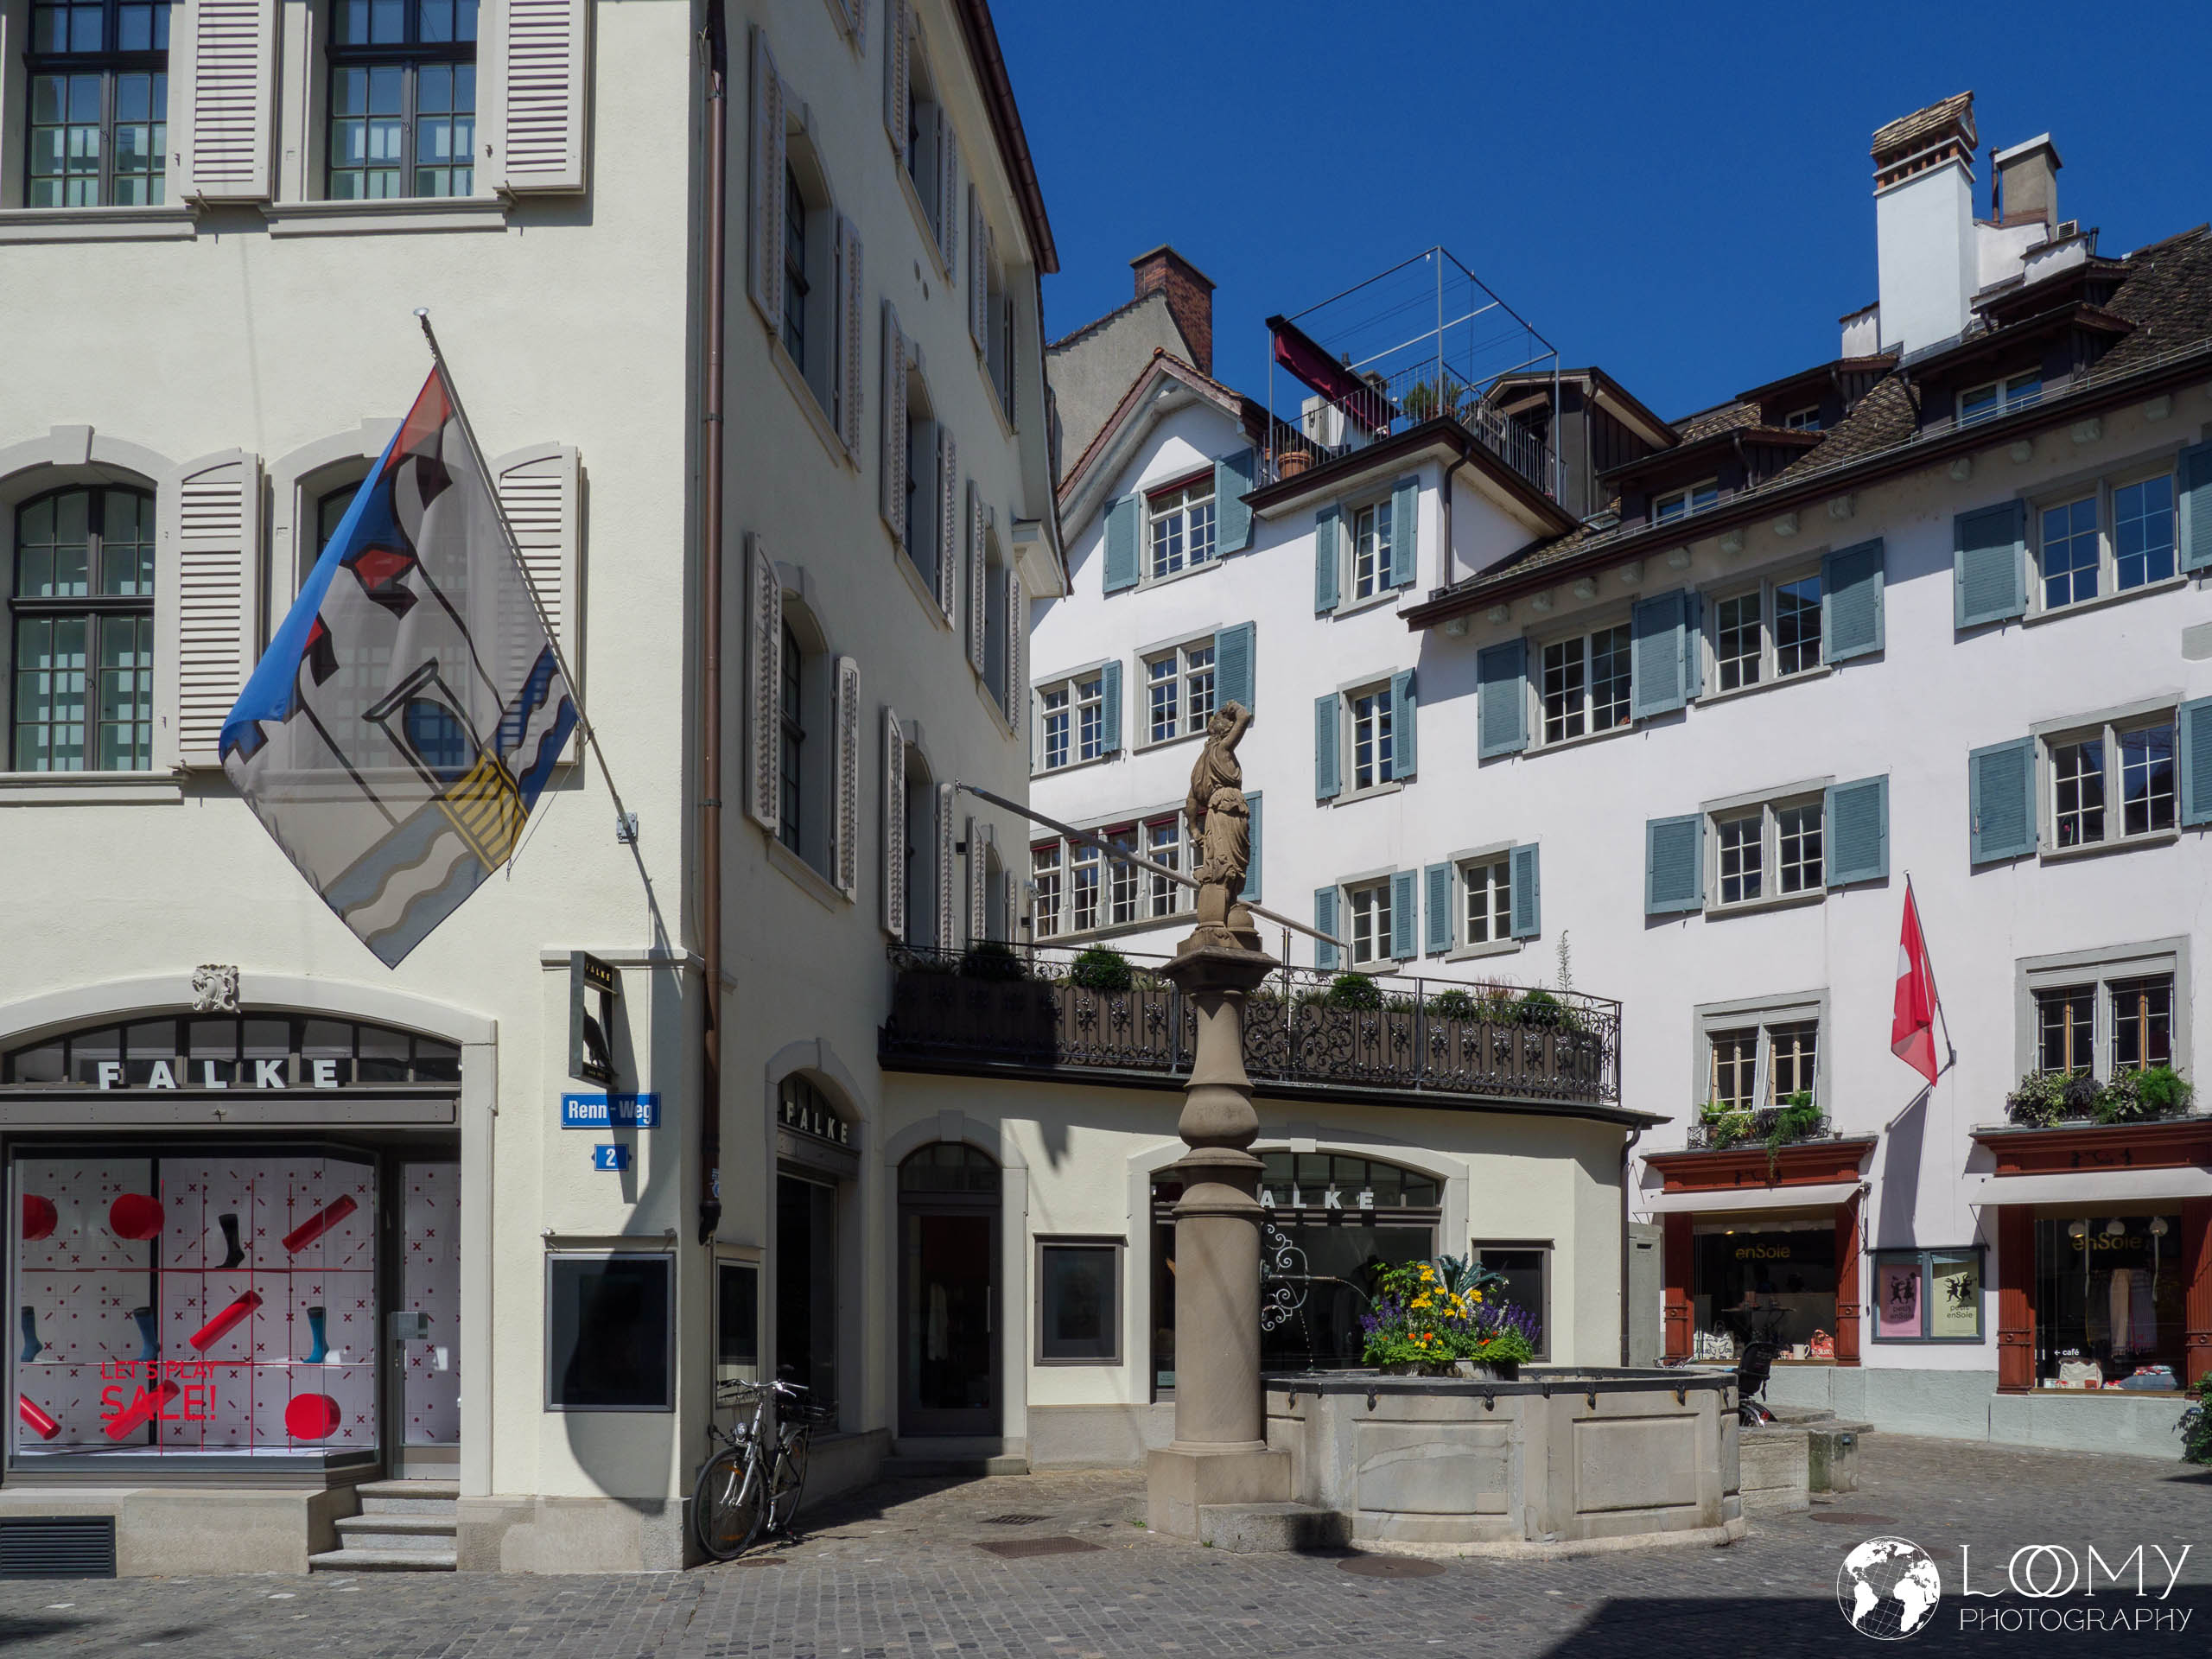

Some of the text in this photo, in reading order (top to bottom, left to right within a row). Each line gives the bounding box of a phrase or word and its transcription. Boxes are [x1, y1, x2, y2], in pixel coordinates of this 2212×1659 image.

[586, 962, 611, 982] FALKE
[98, 1059, 339, 1090] FALKE
[786, 1100, 849, 1144] FALKE
[606, 1147, 616, 1166] 2
[1259, 1190, 1375, 1210] ALKE
[1735, 1244, 1791, 1259] enSoie
[101, 1360, 216, 1380] LET'S PLAY
[100, 1384, 216, 1421] SALE!
